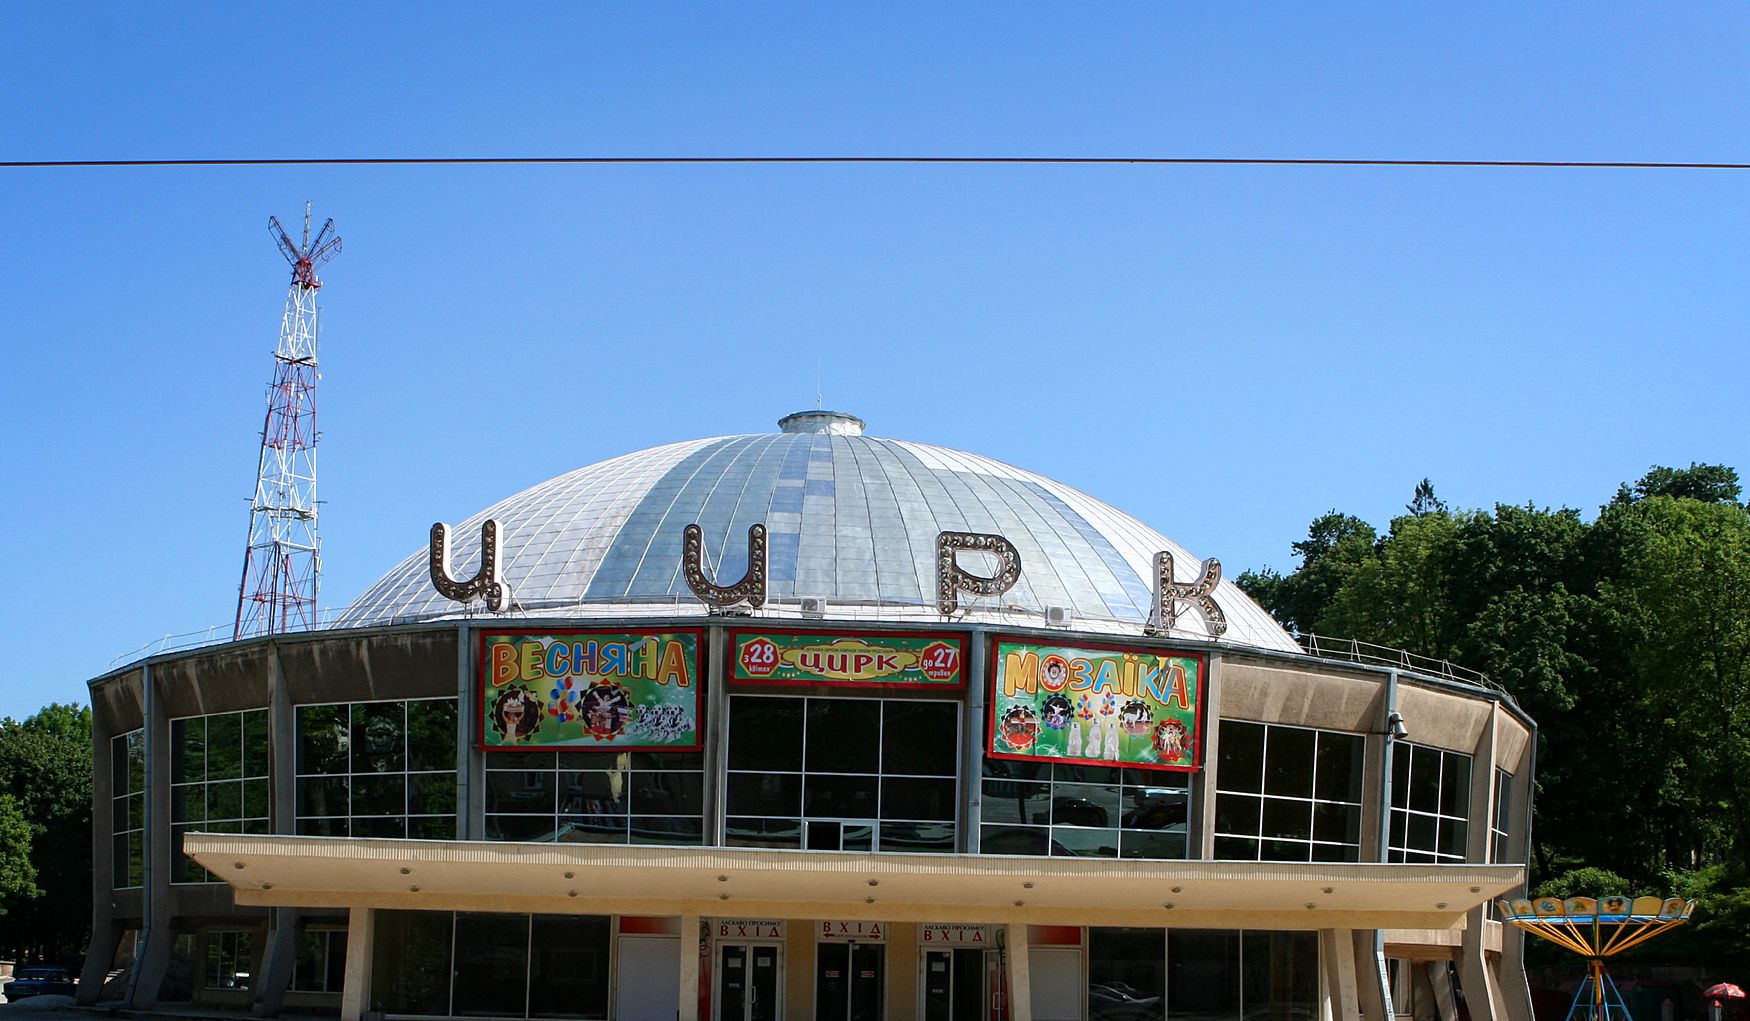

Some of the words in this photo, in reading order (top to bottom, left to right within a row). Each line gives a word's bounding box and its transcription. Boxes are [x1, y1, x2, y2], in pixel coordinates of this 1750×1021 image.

[430, 519, 1226, 636] ЦИРК
[491, 636, 690, 687] ВЕСНЯНА
[749, 643, 775, 664] 28
[799, 653, 900, 675] ЦИРК
[933, 648, 956, 668] 27
[1004, 652, 1190, 710] МОЗАЇКА
[720, 925, 780, 937] ВХІД
[823, 921, 881, 934] ВХІД
[923, 930, 983, 941] ВХІД
